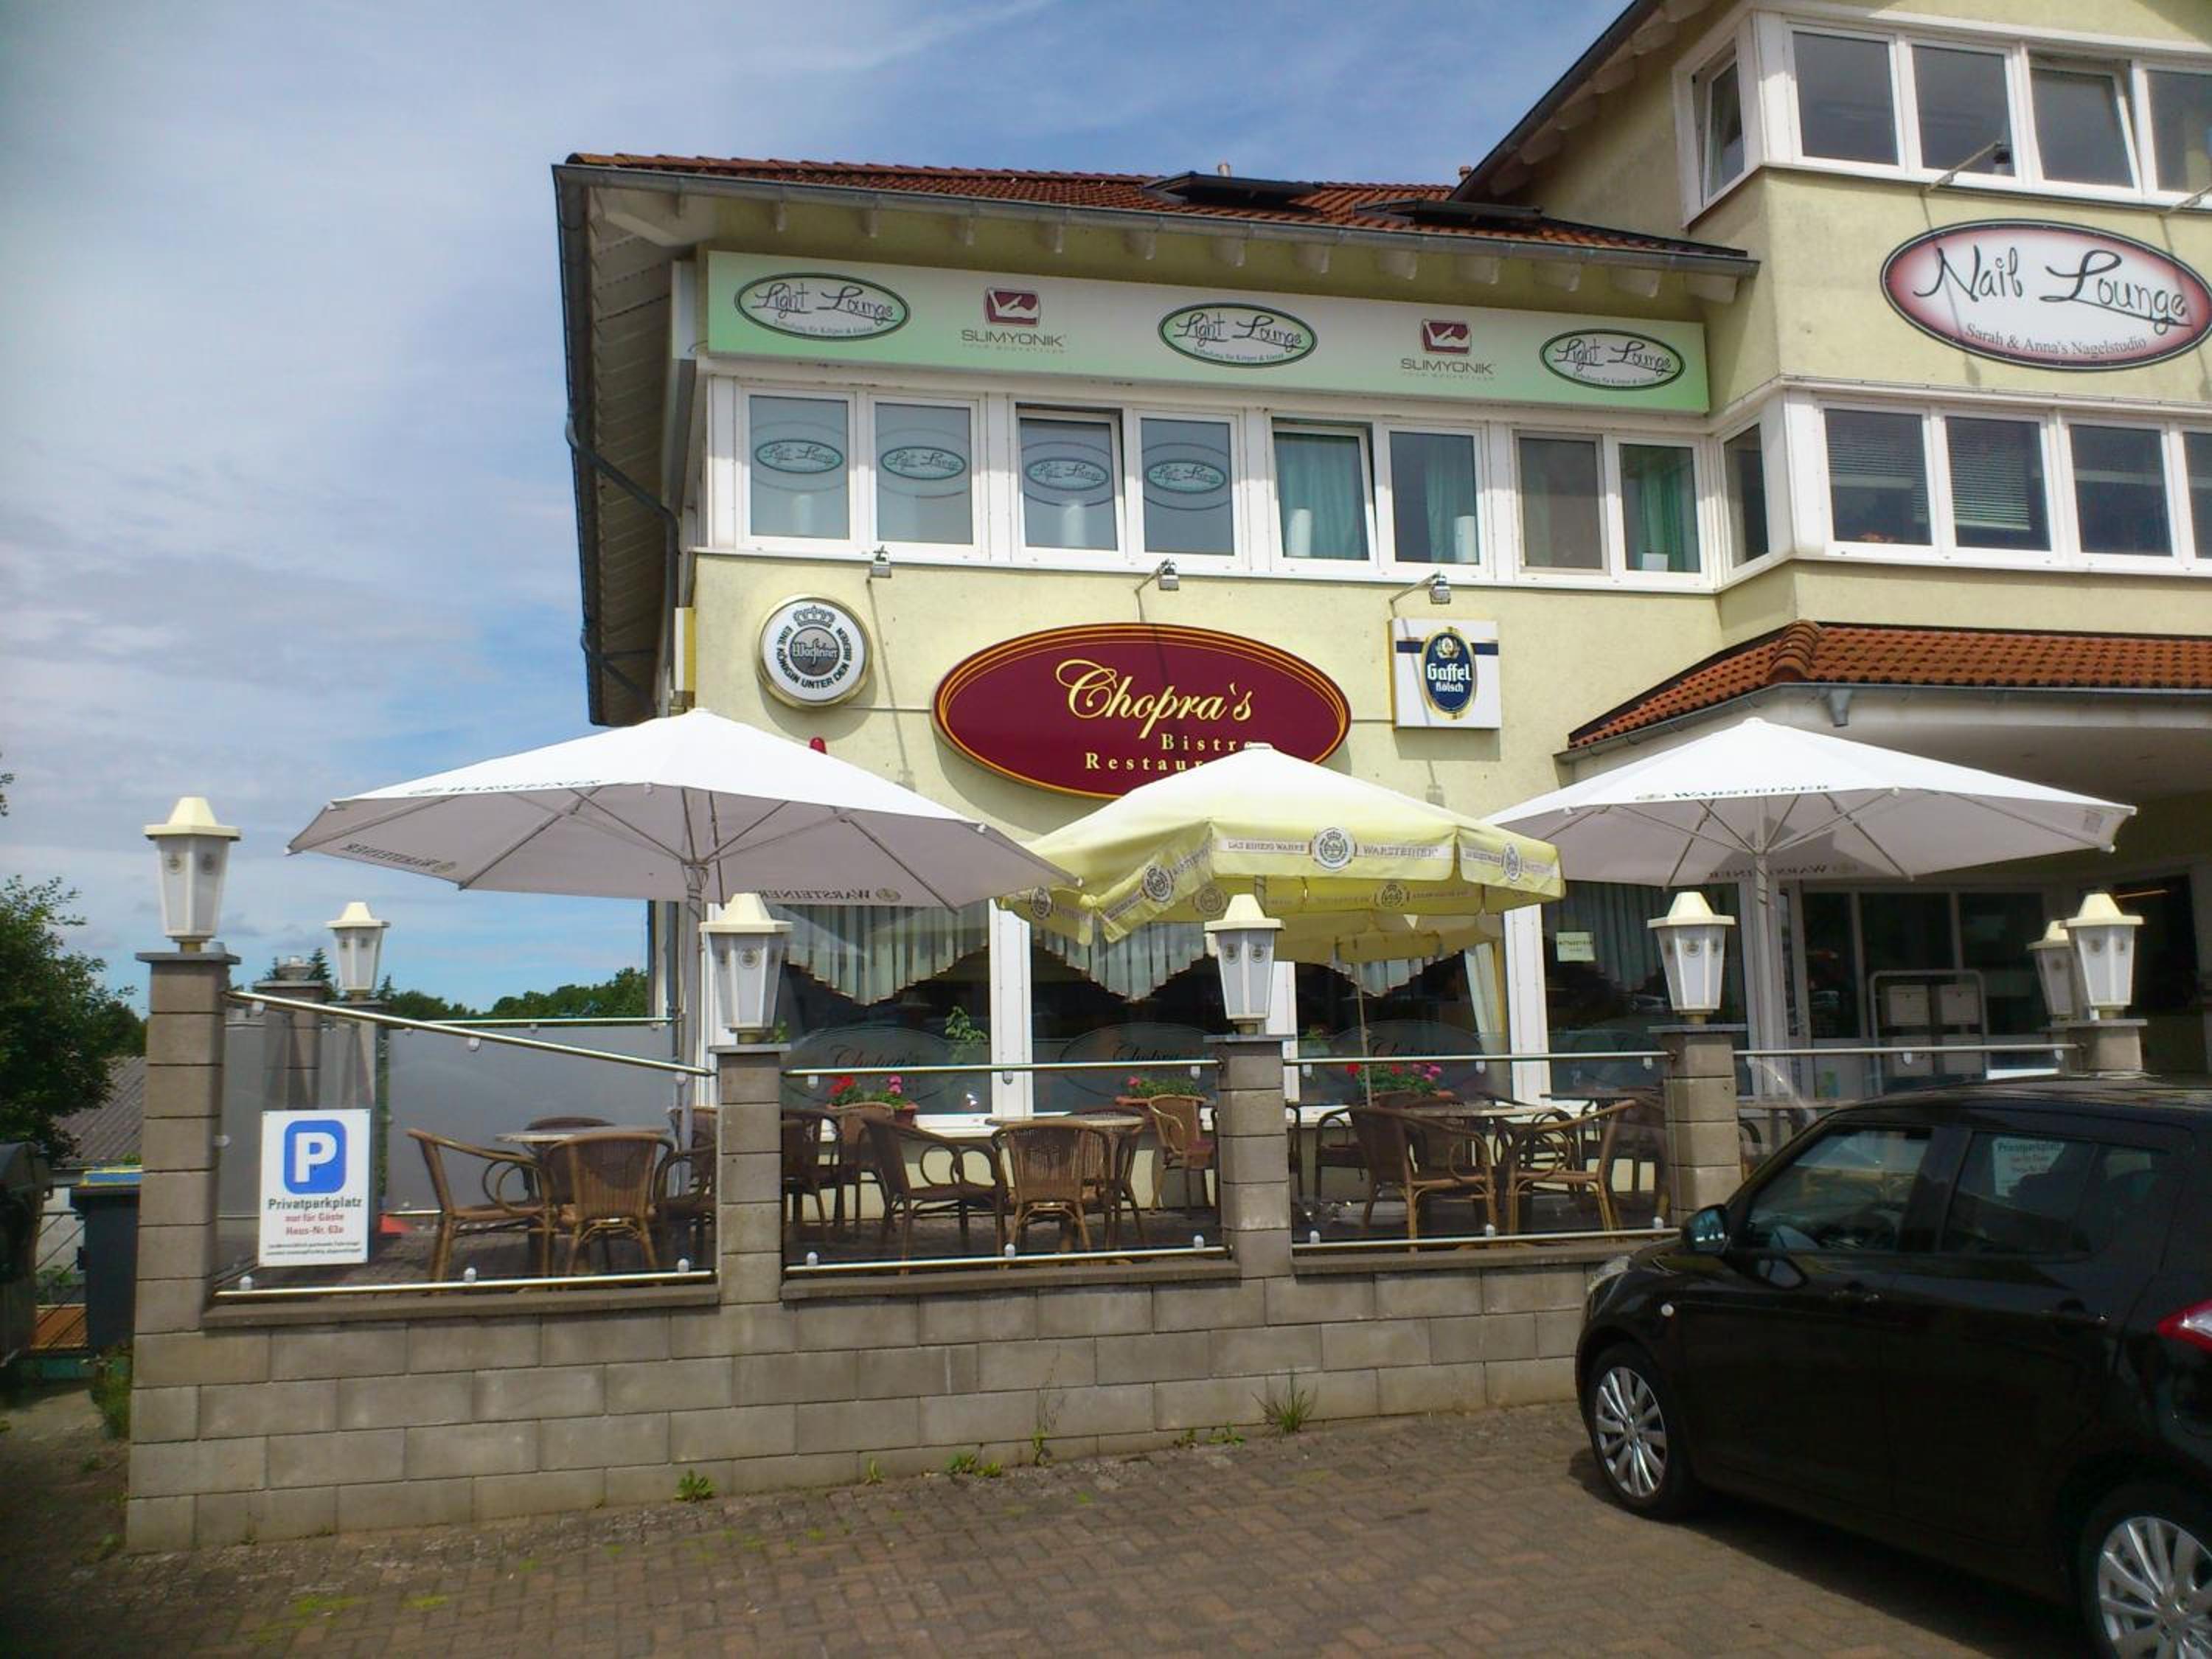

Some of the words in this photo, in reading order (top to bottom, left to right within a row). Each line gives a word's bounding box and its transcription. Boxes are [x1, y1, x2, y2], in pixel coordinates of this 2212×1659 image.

[1913, 245, 2023, 302] Nail
[2039, 250, 2192, 335] Lounge
[751, 282, 812, 319] Light
[815, 285, 898, 327] Lounge
[961, 330, 1063, 347] SLIMYONIK
[1173, 312, 1229, 347] Light
[1231, 315, 1306, 352] Lounge
[1965, 323, 2003, 347] Sarah
[2007, 337, 2019, 349] &
[2023, 339, 2067, 355] Anna's
[2071, 336, 2147, 359] Nagelstudio
[1401, 358, 1493, 375] SLIMYONIK
[1554, 338, 1604, 372] Light
[1607, 341, 1676, 377] Lounge
[776, 625, 793, 645] EINE
[835, 627, 852, 661] BIEREN
[776, 647, 801, 684] KÖNIGIN
[832, 662, 850, 681] DEN
[1426, 663, 1472, 682] Gaffel
[801, 677, 835, 689] UNTER
[1435, 681, 1464, 694] Kölsch
[1055, 658, 1253, 740] Chopra's
[1161, 733, 1252, 752] Bistr
[1085, 752, 1204, 771] Restaur
[268, 1196, 363, 1211] Privatparkplatz
